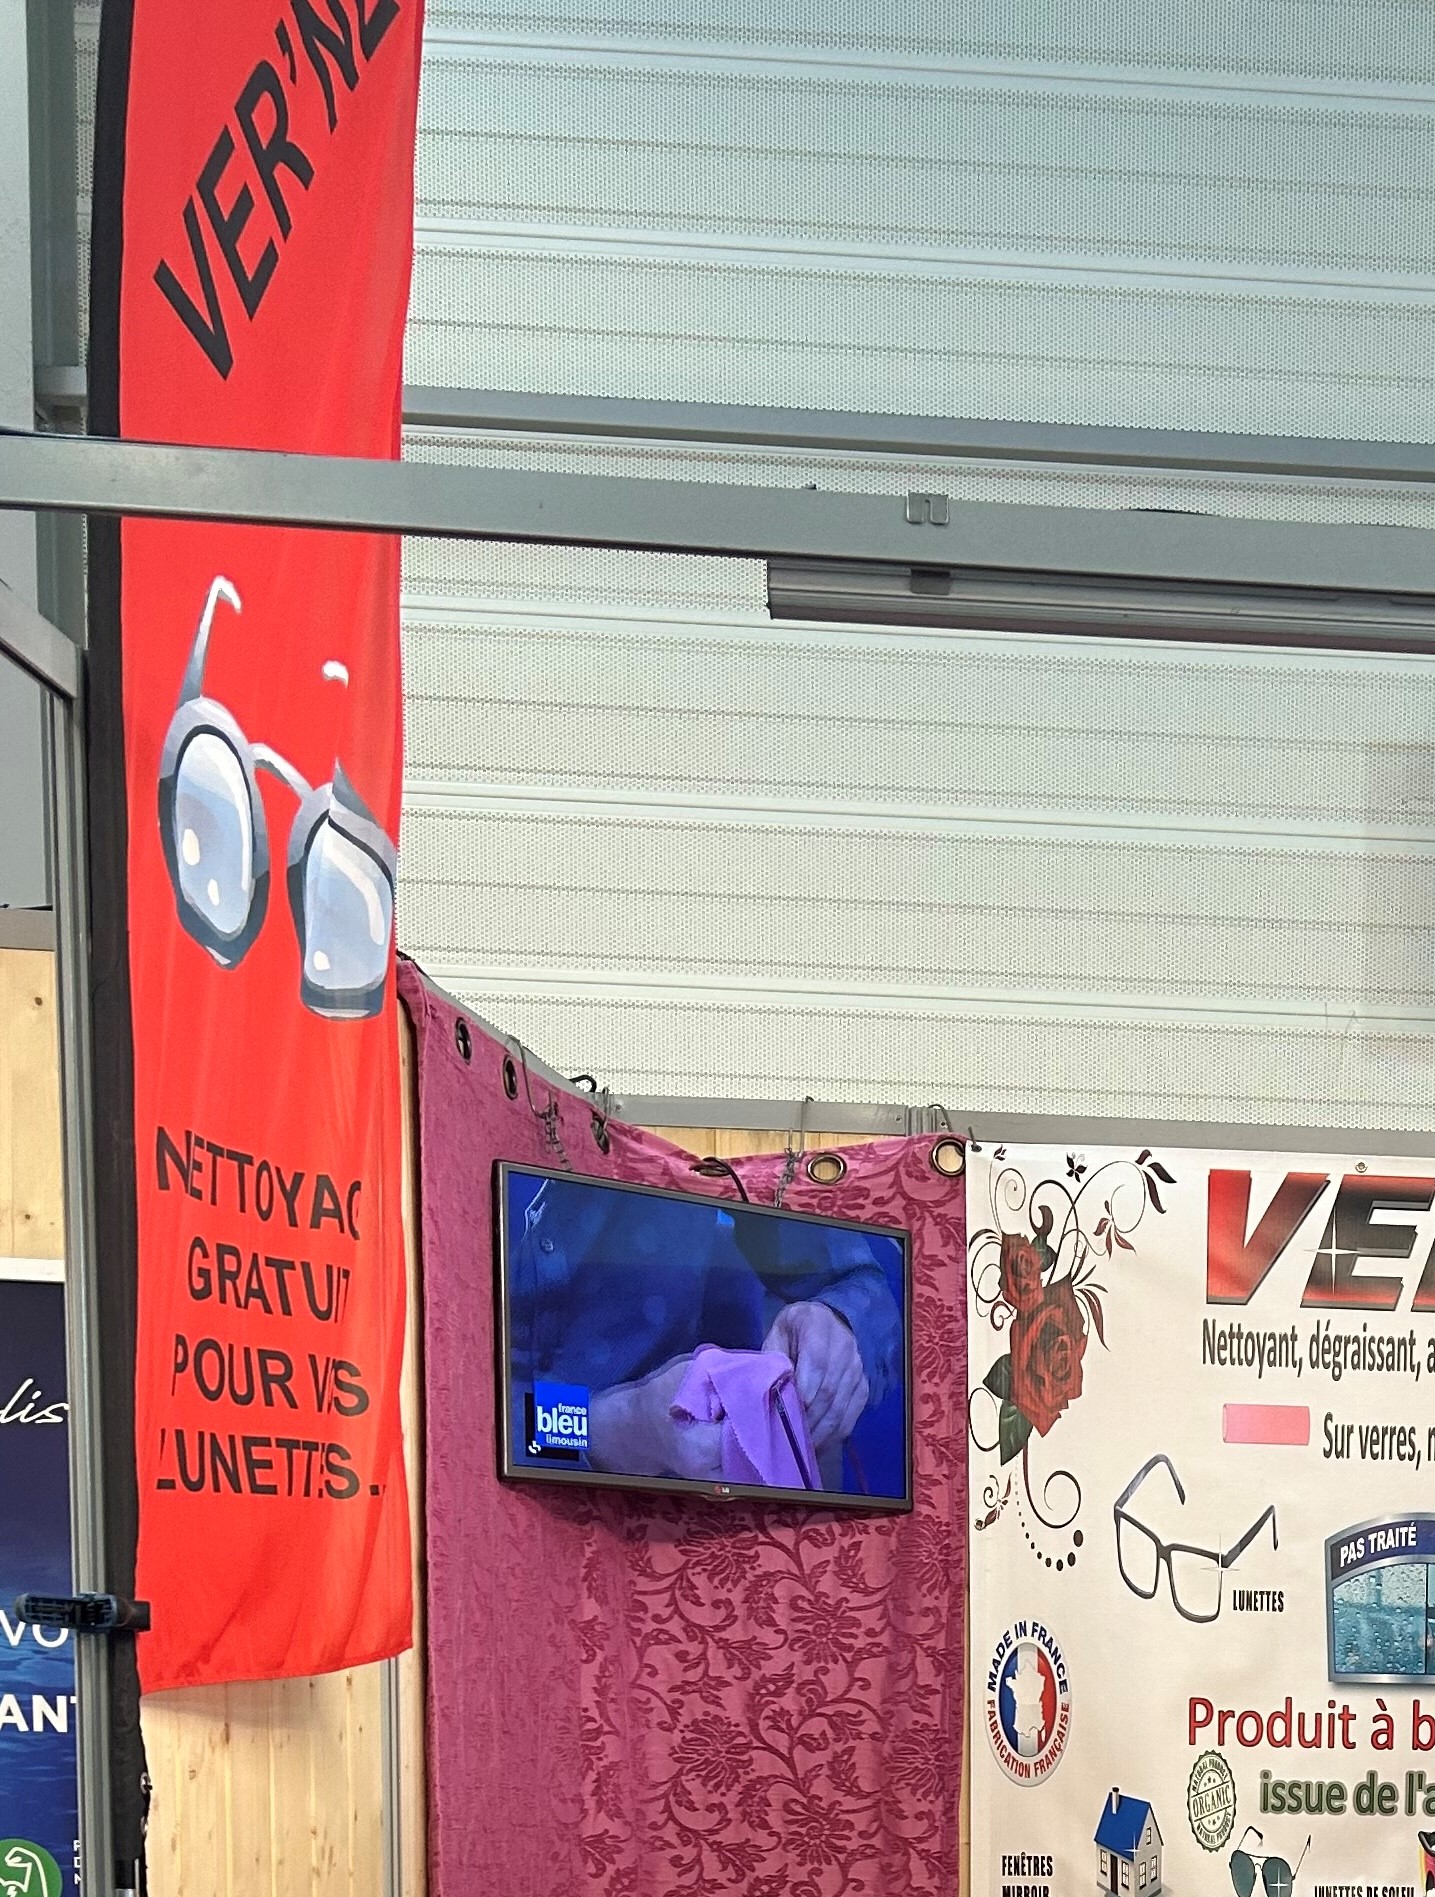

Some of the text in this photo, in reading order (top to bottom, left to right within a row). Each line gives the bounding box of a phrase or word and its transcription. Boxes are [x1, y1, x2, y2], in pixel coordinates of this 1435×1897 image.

[171, 1333, 299, 1410] POUR
[1202, 1318, 1303, 1380] Nettoyant,
[1309, 1319, 1421, 1381] dégraissant,
[537, 1406, 588, 1436] bleu
[1322, 1412, 1354, 1460] Sur
[1359, 1422, 1422, 1471] verres,
[1340, 1521, 1417, 1567] PAS TRAITÉ
[1233, 1590, 1284, 1612] LUNETTES
[987, 1620, 1069, 1694] MADE IN FRANCE
[0, 1694, 77, 1733] AN
[1188, 1696, 1356, 1750] Produit
[1371, 1699, 1395, 1751] à
[987, 1699, 1070, 1779] FABRICATION FRANÇAISE
[1192, 1785, 1231, 1818] ORGANIC
[1260, 1769, 1347, 1816] issue
[1353, 1768, 1399, 1817] de
[1002, 1852, 1053, 1877] FENÊTRES
